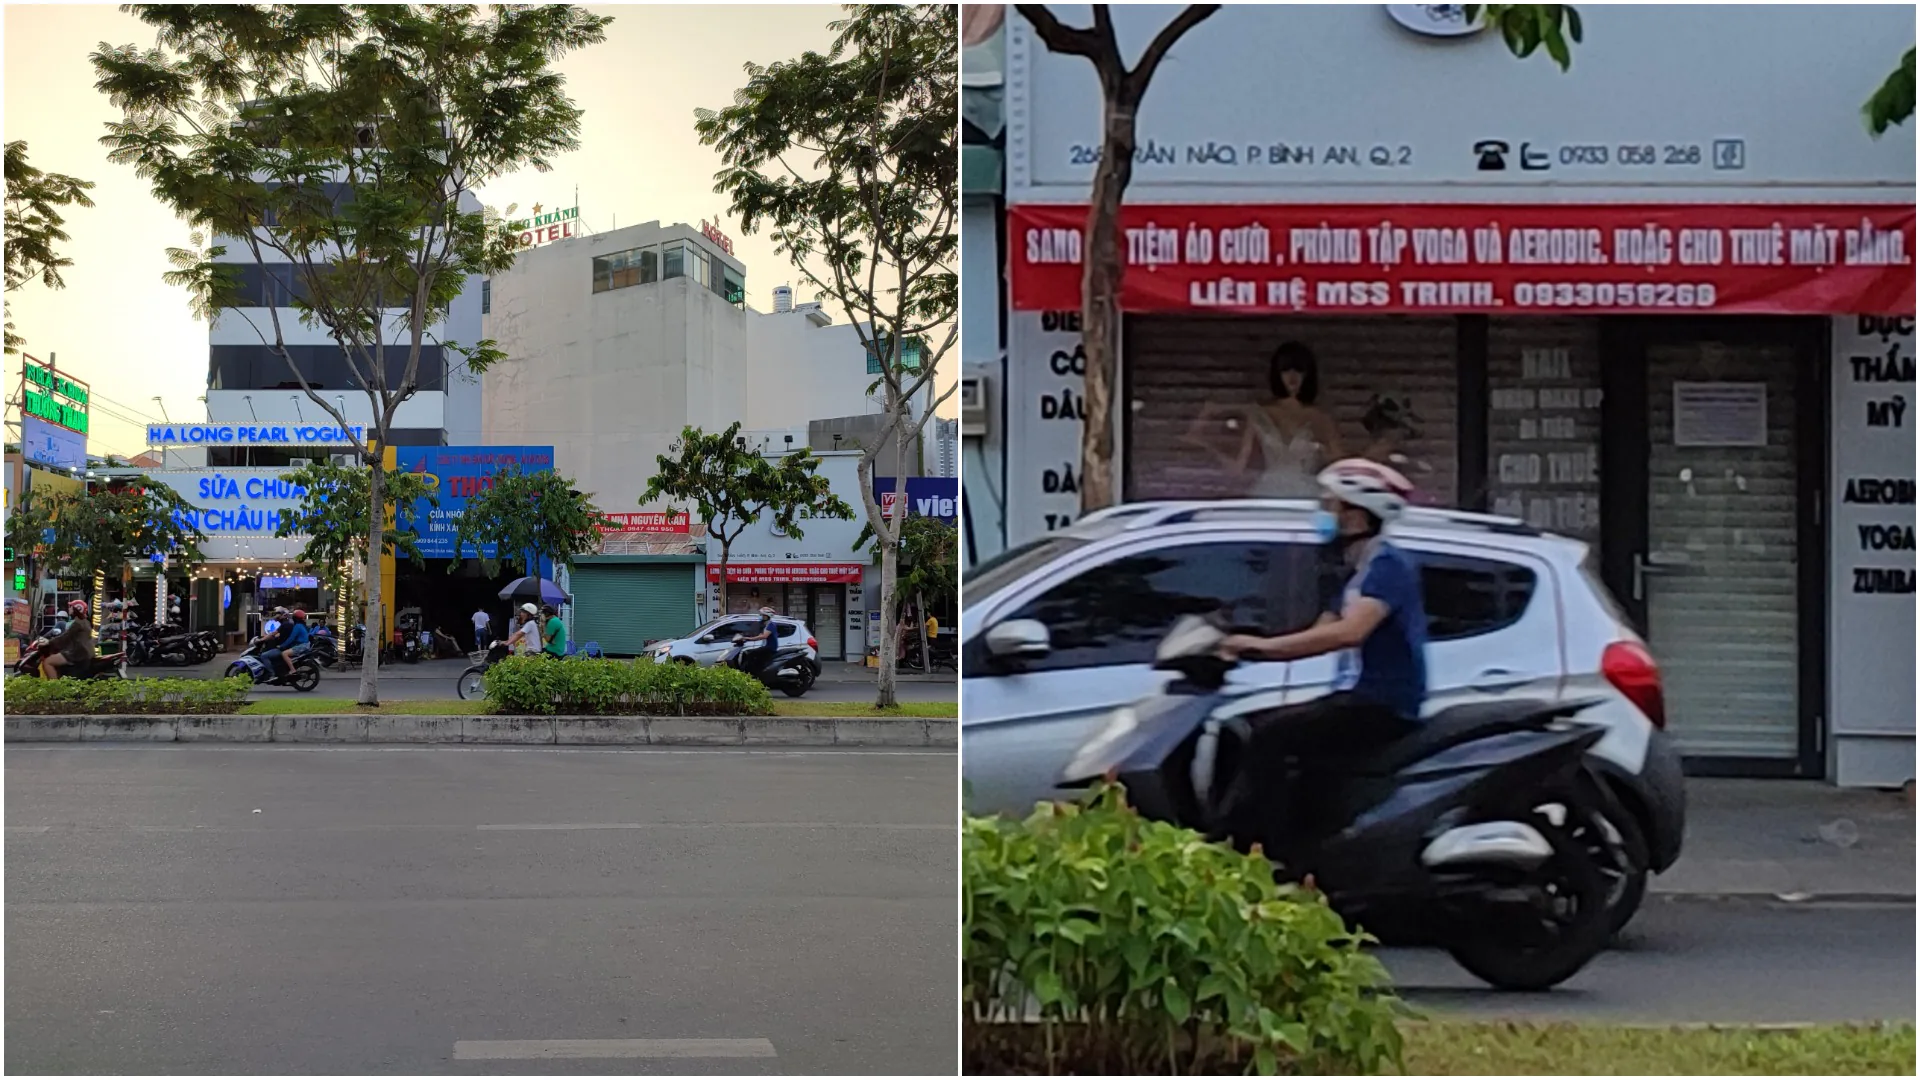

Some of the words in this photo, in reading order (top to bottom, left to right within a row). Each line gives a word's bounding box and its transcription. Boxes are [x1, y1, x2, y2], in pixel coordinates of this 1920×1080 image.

[1558, 145, 1609, 165] 0933
[1616, 145, 1656, 165] 058
[1663, 144, 1702, 165] 268
[506, 222, 572, 248] OTEL
[1026, 228, 1082, 264] SANG
[1185, 222, 1213, 264] ÁO
[1290, 221, 1362, 264] PHÒNG
[1367, 221, 1408, 272] TẬP
[1412, 228, 1469, 264] YOGA
[1473, 221, 1503, 264] VÀ
[1678, 228, 1723, 265] CHO
[1730, 221, 1784, 265] THUÊ
[1790, 223, 1838, 273] MẶT
[1190, 277, 1256, 306] LIÊN
[1267, 277, 1306, 311] HỆ
[1317, 281, 1390, 306] MSS
[150, 427, 176, 442] HA
[180, 427, 234, 442] LONG
[238, 427, 289, 442] PEARL
[203, 504, 262, 530] CHÂU
[631, 514, 665, 525] NGUYÊN
[1858, 524, 1916, 550] YOGA
